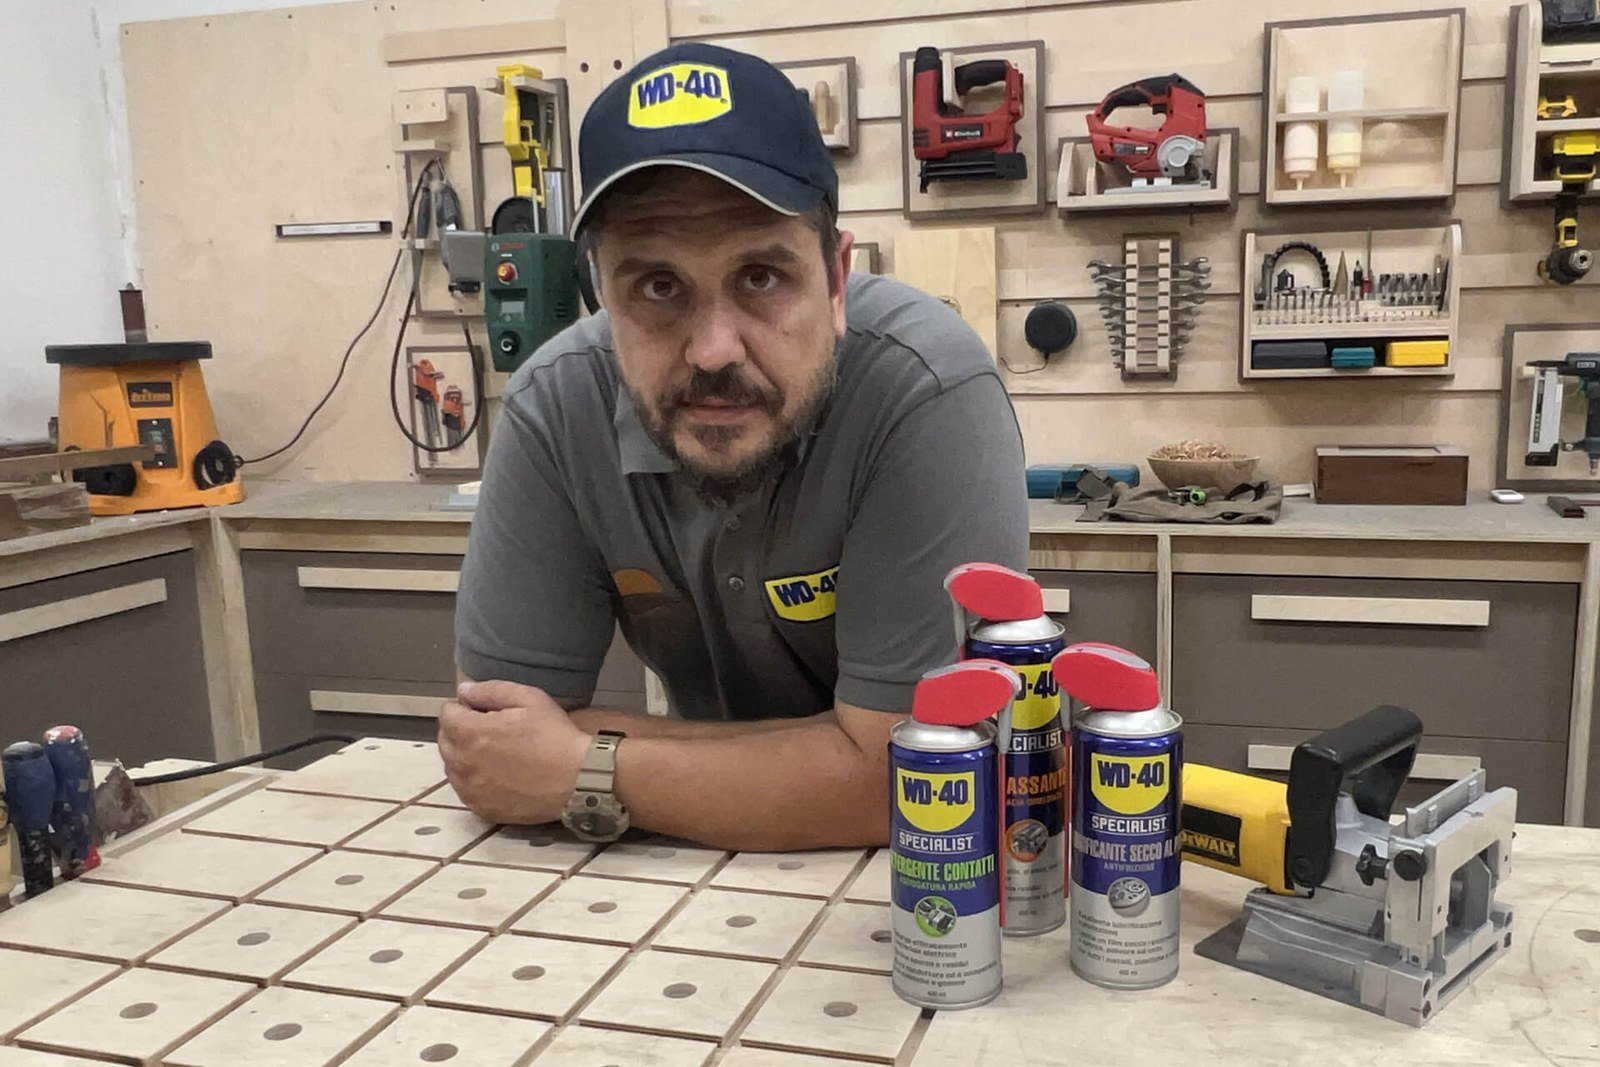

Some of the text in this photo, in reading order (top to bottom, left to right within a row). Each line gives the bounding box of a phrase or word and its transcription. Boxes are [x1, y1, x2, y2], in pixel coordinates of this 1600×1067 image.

[637, 69, 722, 110] WD-40
[1014, 669, 1059, 701] D-40
[1011, 730, 1063, 751] CIALIST
[1006, 768, 1066, 796] ASSANT
[1096, 760, 1165, 788] WD-40
[901, 775, 969, 806] WD-40
[1091, 815, 1168, 833] SPECIALIST
[899, 831, 974, 852] SPECIALIST
[1129, 841, 1162, 862] SECCO
[1164, 838, 1179, 859] AL
[943, 853, 995, 881] CONTATTI
